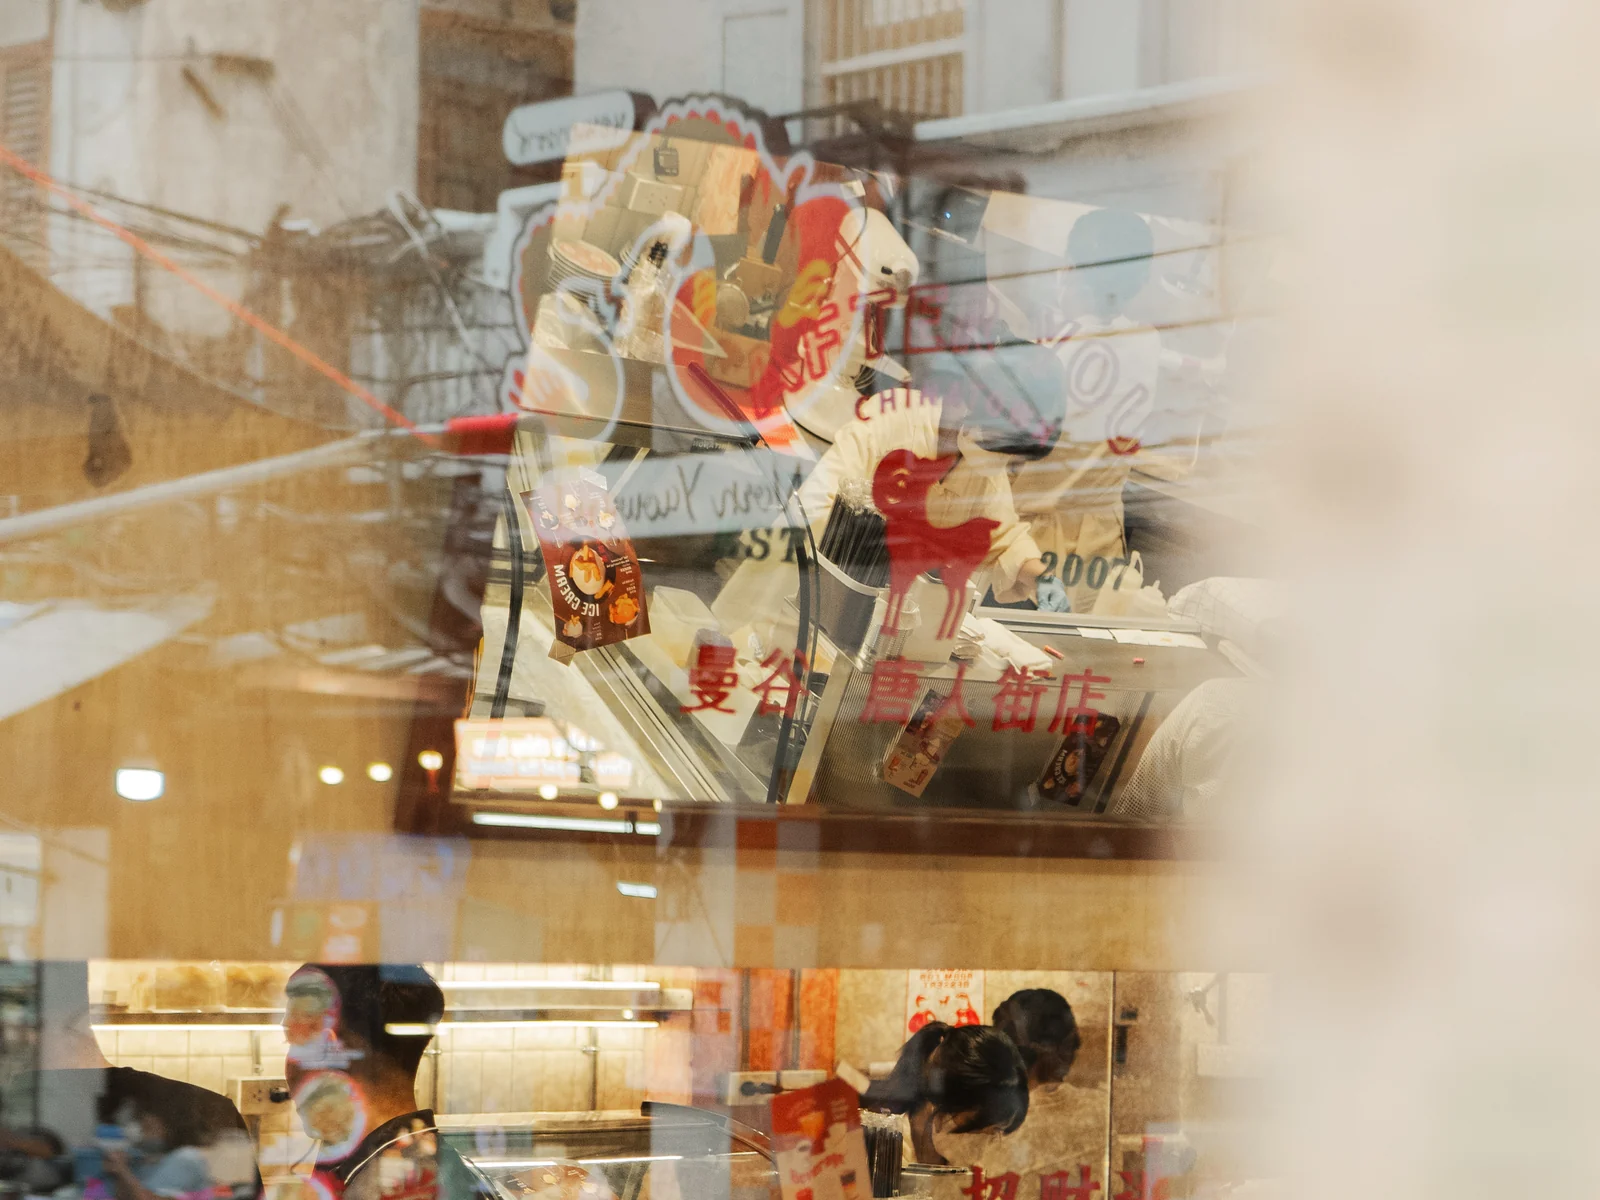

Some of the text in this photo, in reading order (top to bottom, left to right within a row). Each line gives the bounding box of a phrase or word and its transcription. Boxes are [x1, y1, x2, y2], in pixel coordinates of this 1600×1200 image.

[748, 281, 1000, 420] AFTER
[1036, 551, 1131, 591] 2007
[679, 644, 1114, 738] 曼谷 唐人街店
